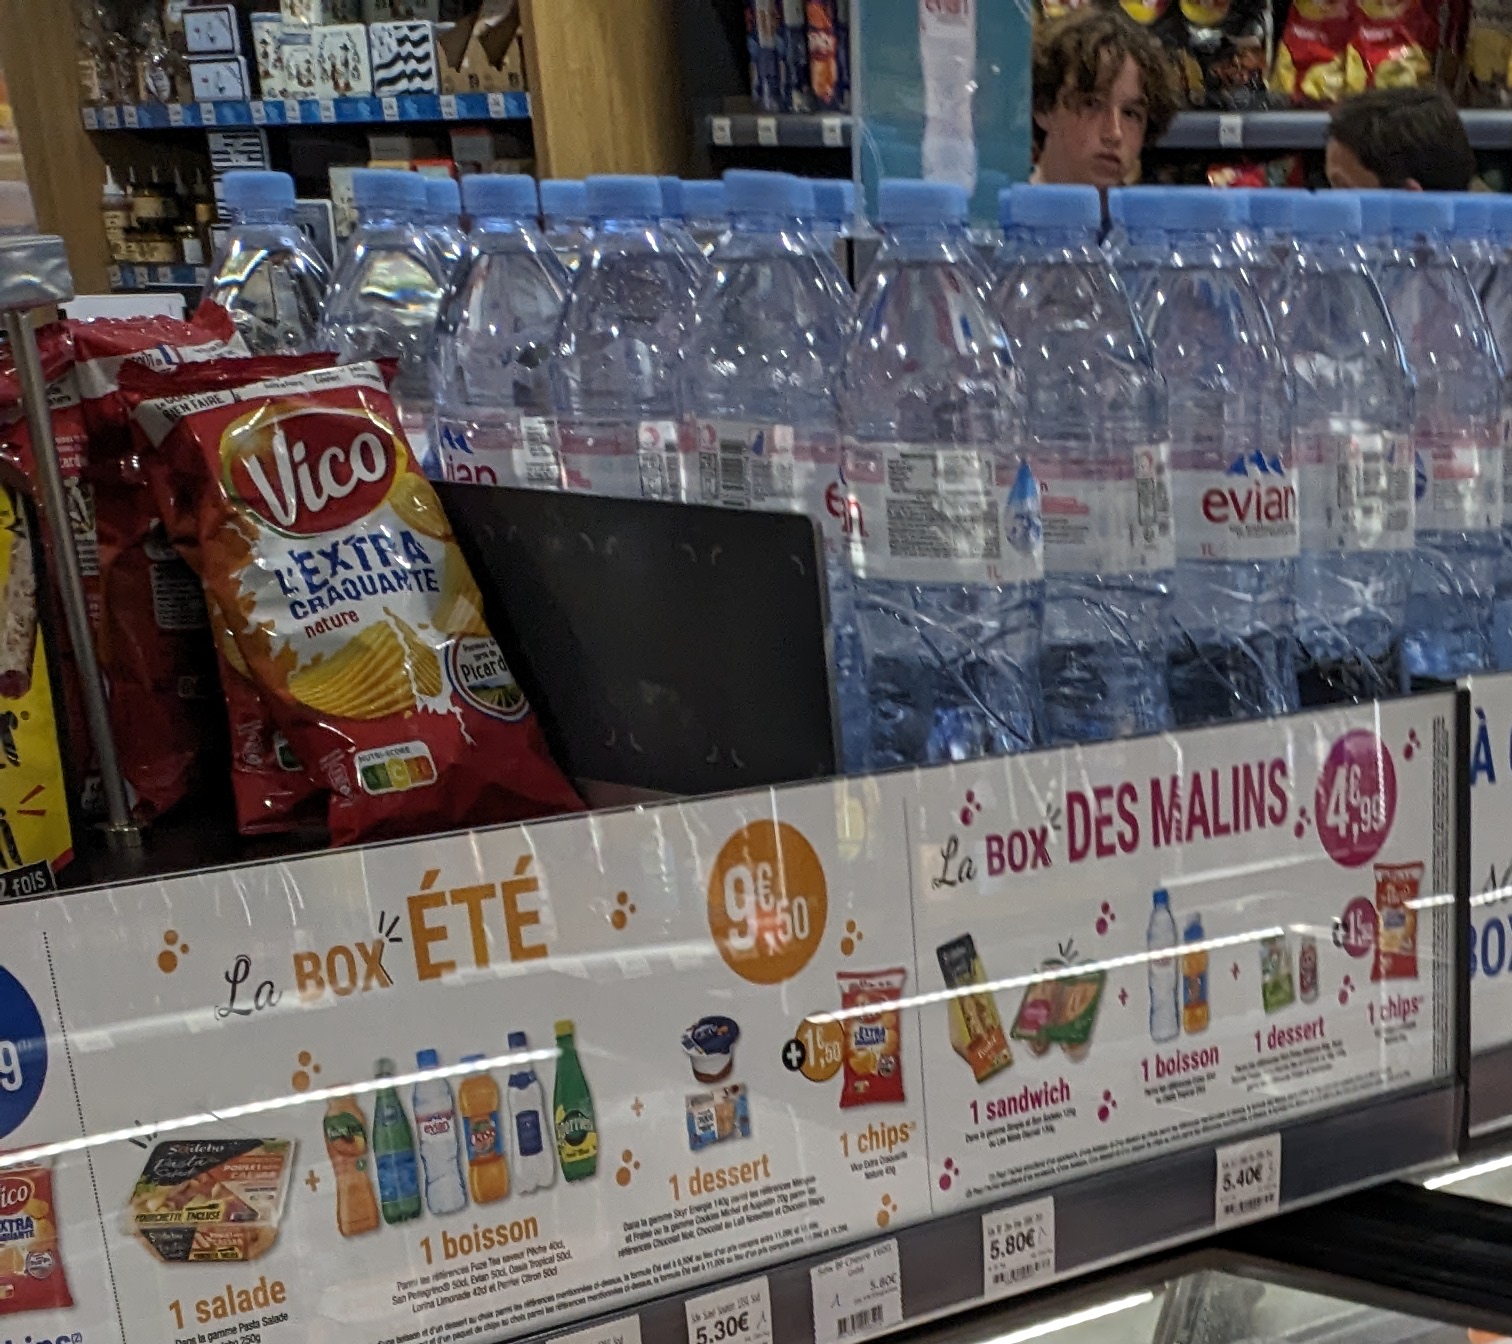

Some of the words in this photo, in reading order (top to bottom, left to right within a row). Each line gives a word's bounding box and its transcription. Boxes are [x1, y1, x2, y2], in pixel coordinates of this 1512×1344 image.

[248, 422, 388, 528] Vico
[1203, 480, 1296, 525] evian
[289, 566, 441, 620] CRAQUANTE
[304, 609, 361, 640] nature
[1470, 706, 1496, 787] À
[931, 838, 977, 891] La
[985, 826, 1056, 877] BOX
[1065, 783, 1141, 863] DES
[1151, 757, 1289, 848] MALINS
[214, 953, 283, 1021] La
[293, 937, 394, 1000] BOX
[406, 854, 549, 983] ÉTÉ
[1254, 1030, 1264, 1052] 1
[1268, 1015, 1326, 1050] dessert
[1141, 1058, 1151, 1082] 1
[1155, 1044, 1220, 1079] boisson
[970, 1100, 980, 1125] 1
[985, 1076, 1072, 1121] sandwich
[839, 1134, 849, 1158] 1
[668, 1175, 680, 1201] 1
[689, 1153, 771, 1197] dessert
[1221, 1163, 1263, 1192] 5.40€
[419, 1236, 433, 1265] 1
[441, 1215, 539, 1261] boisson
[988, 1226, 1038, 1260] 5.80€
[169, 1299, 184, 1330] 1
[195, 1275, 288, 1324] salade
